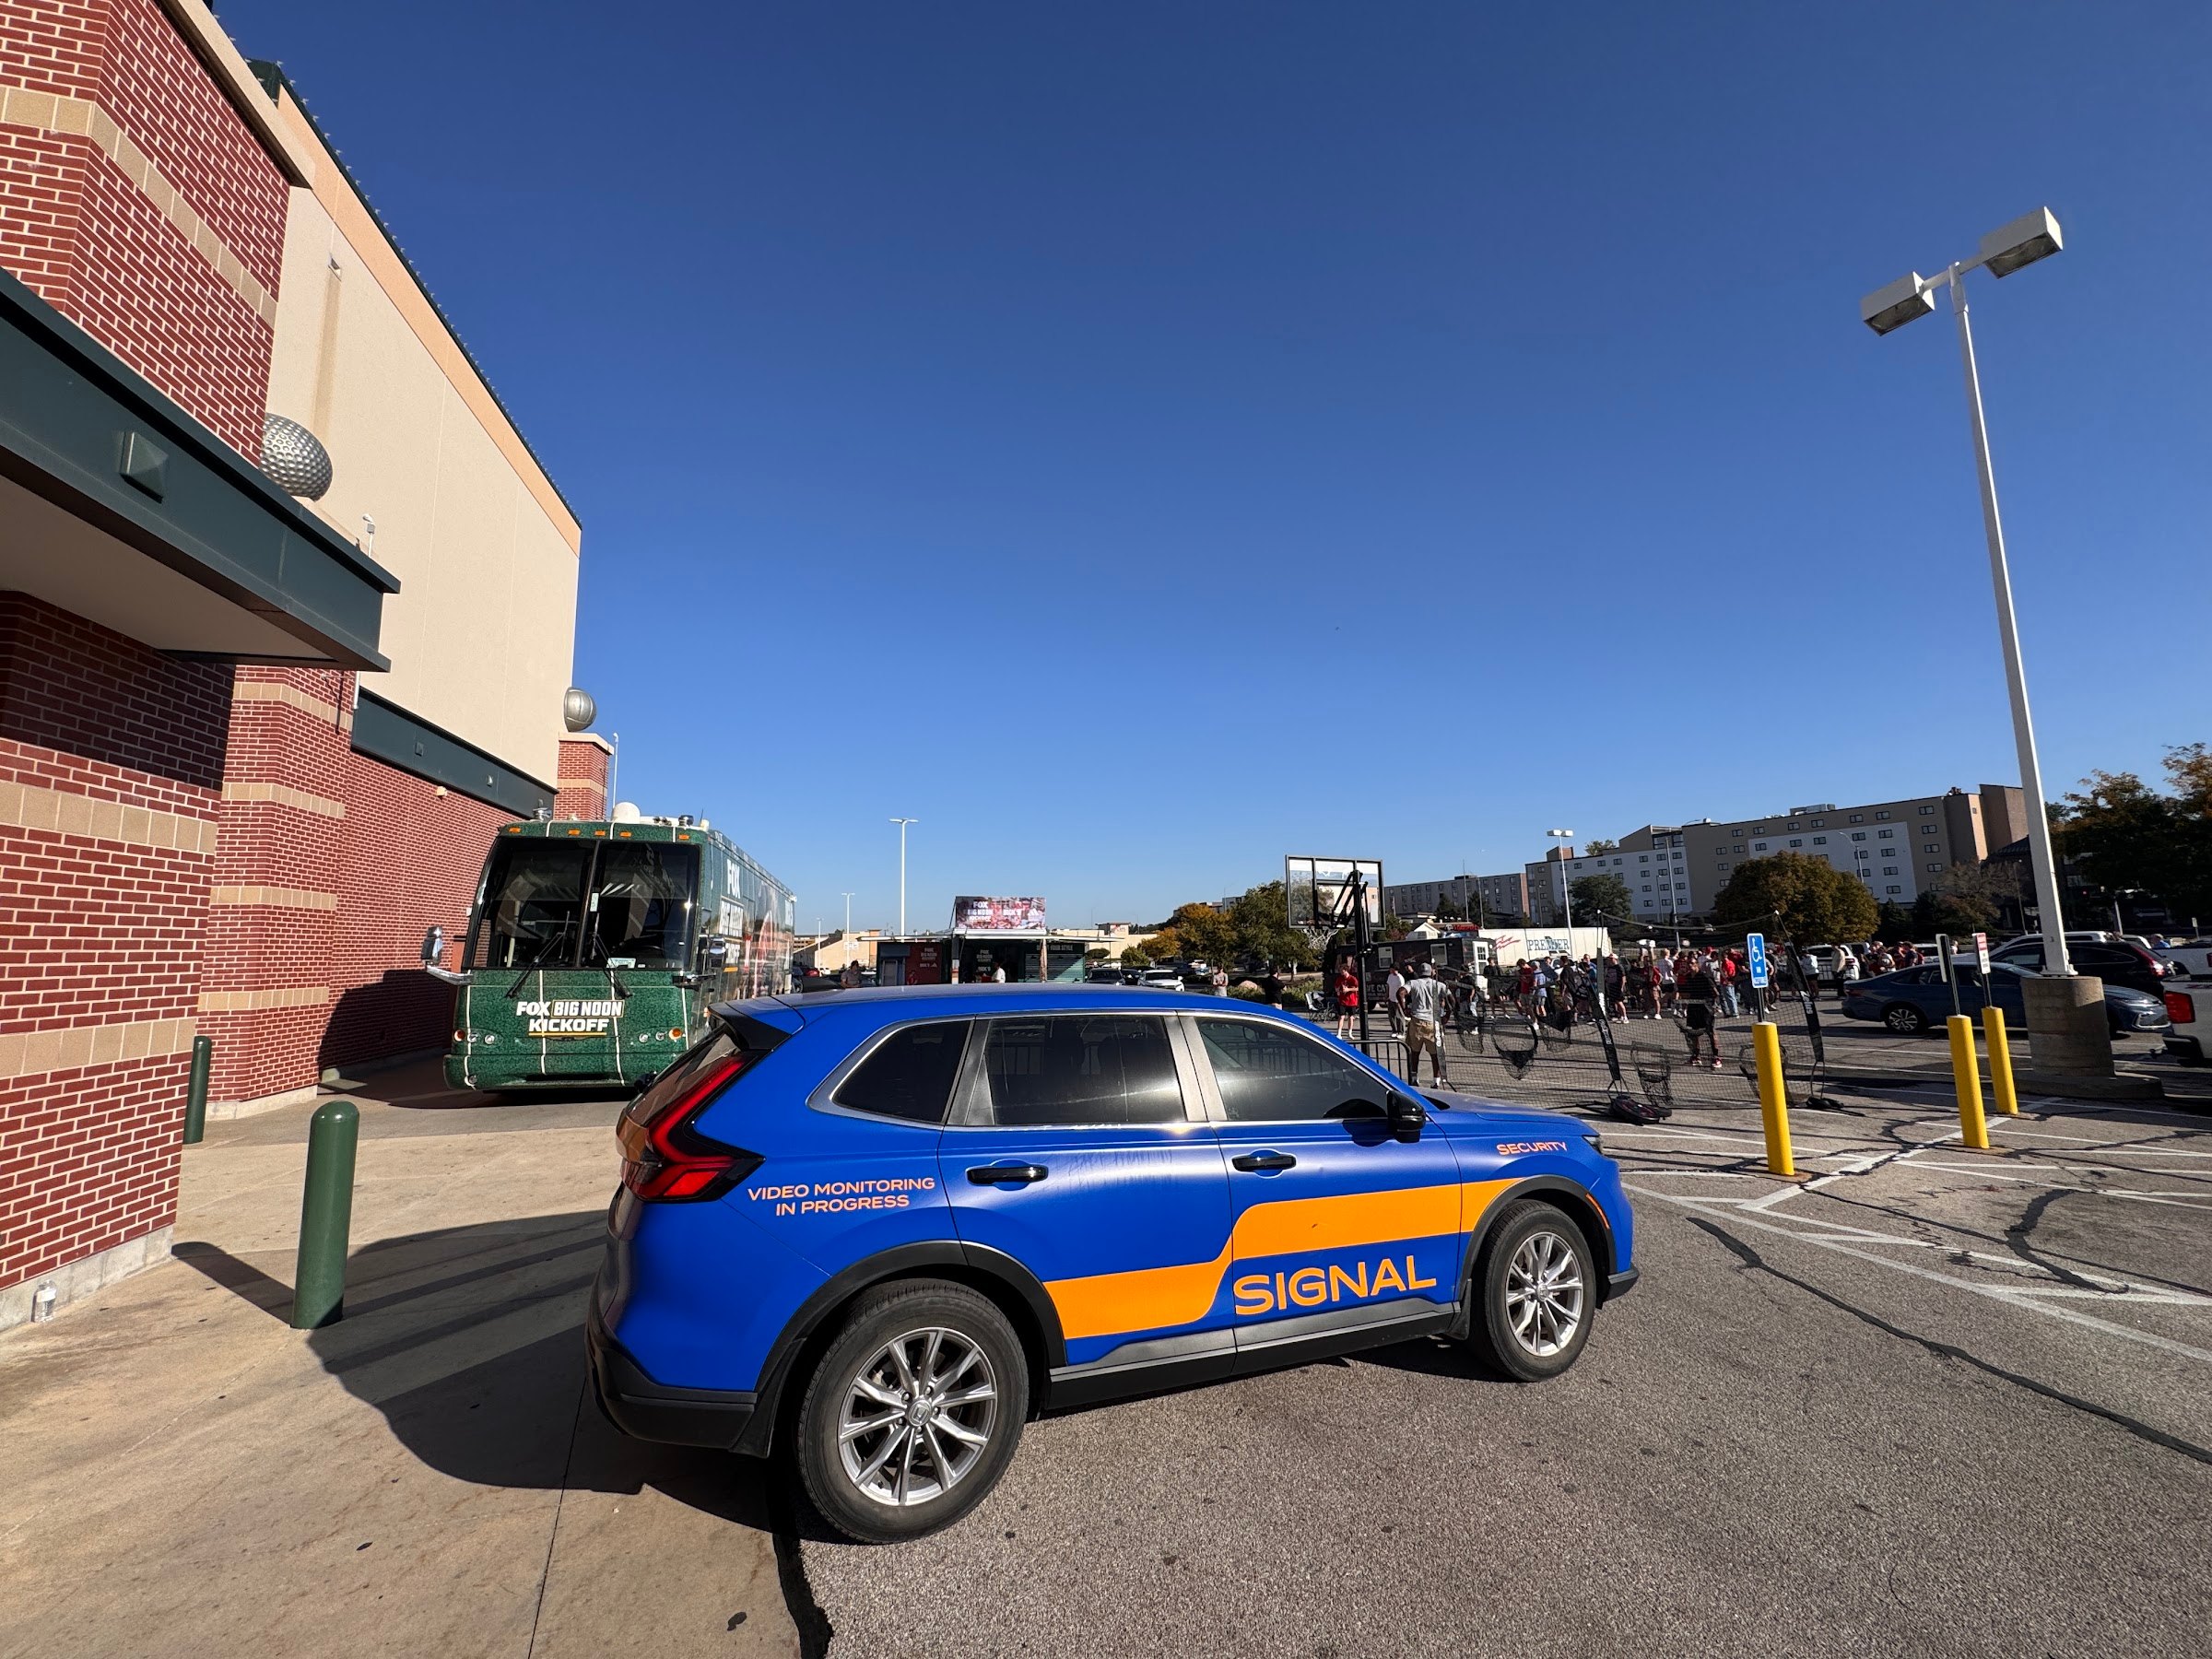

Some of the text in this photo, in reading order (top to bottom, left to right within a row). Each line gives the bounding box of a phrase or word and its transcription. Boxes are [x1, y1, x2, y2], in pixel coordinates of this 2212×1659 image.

[726, 858, 741, 900] FOX
[973, 900, 989, 909] FOX
[1527, 938, 1570, 951] PREMIER
[516, 1001, 623, 1017] FOX BIG NOON
[1799, 990, 1814, 1015] Zelus
[528, 1018, 610, 1032] KICKOFF
[1496, 1141, 1568, 1156] SECURITY
[747, 1177, 935, 1201] VIDEO MONITORING
[776, 1194, 910, 1217] IN PROGRESS
[1233, 1254, 1437, 1316] SIGNAL
